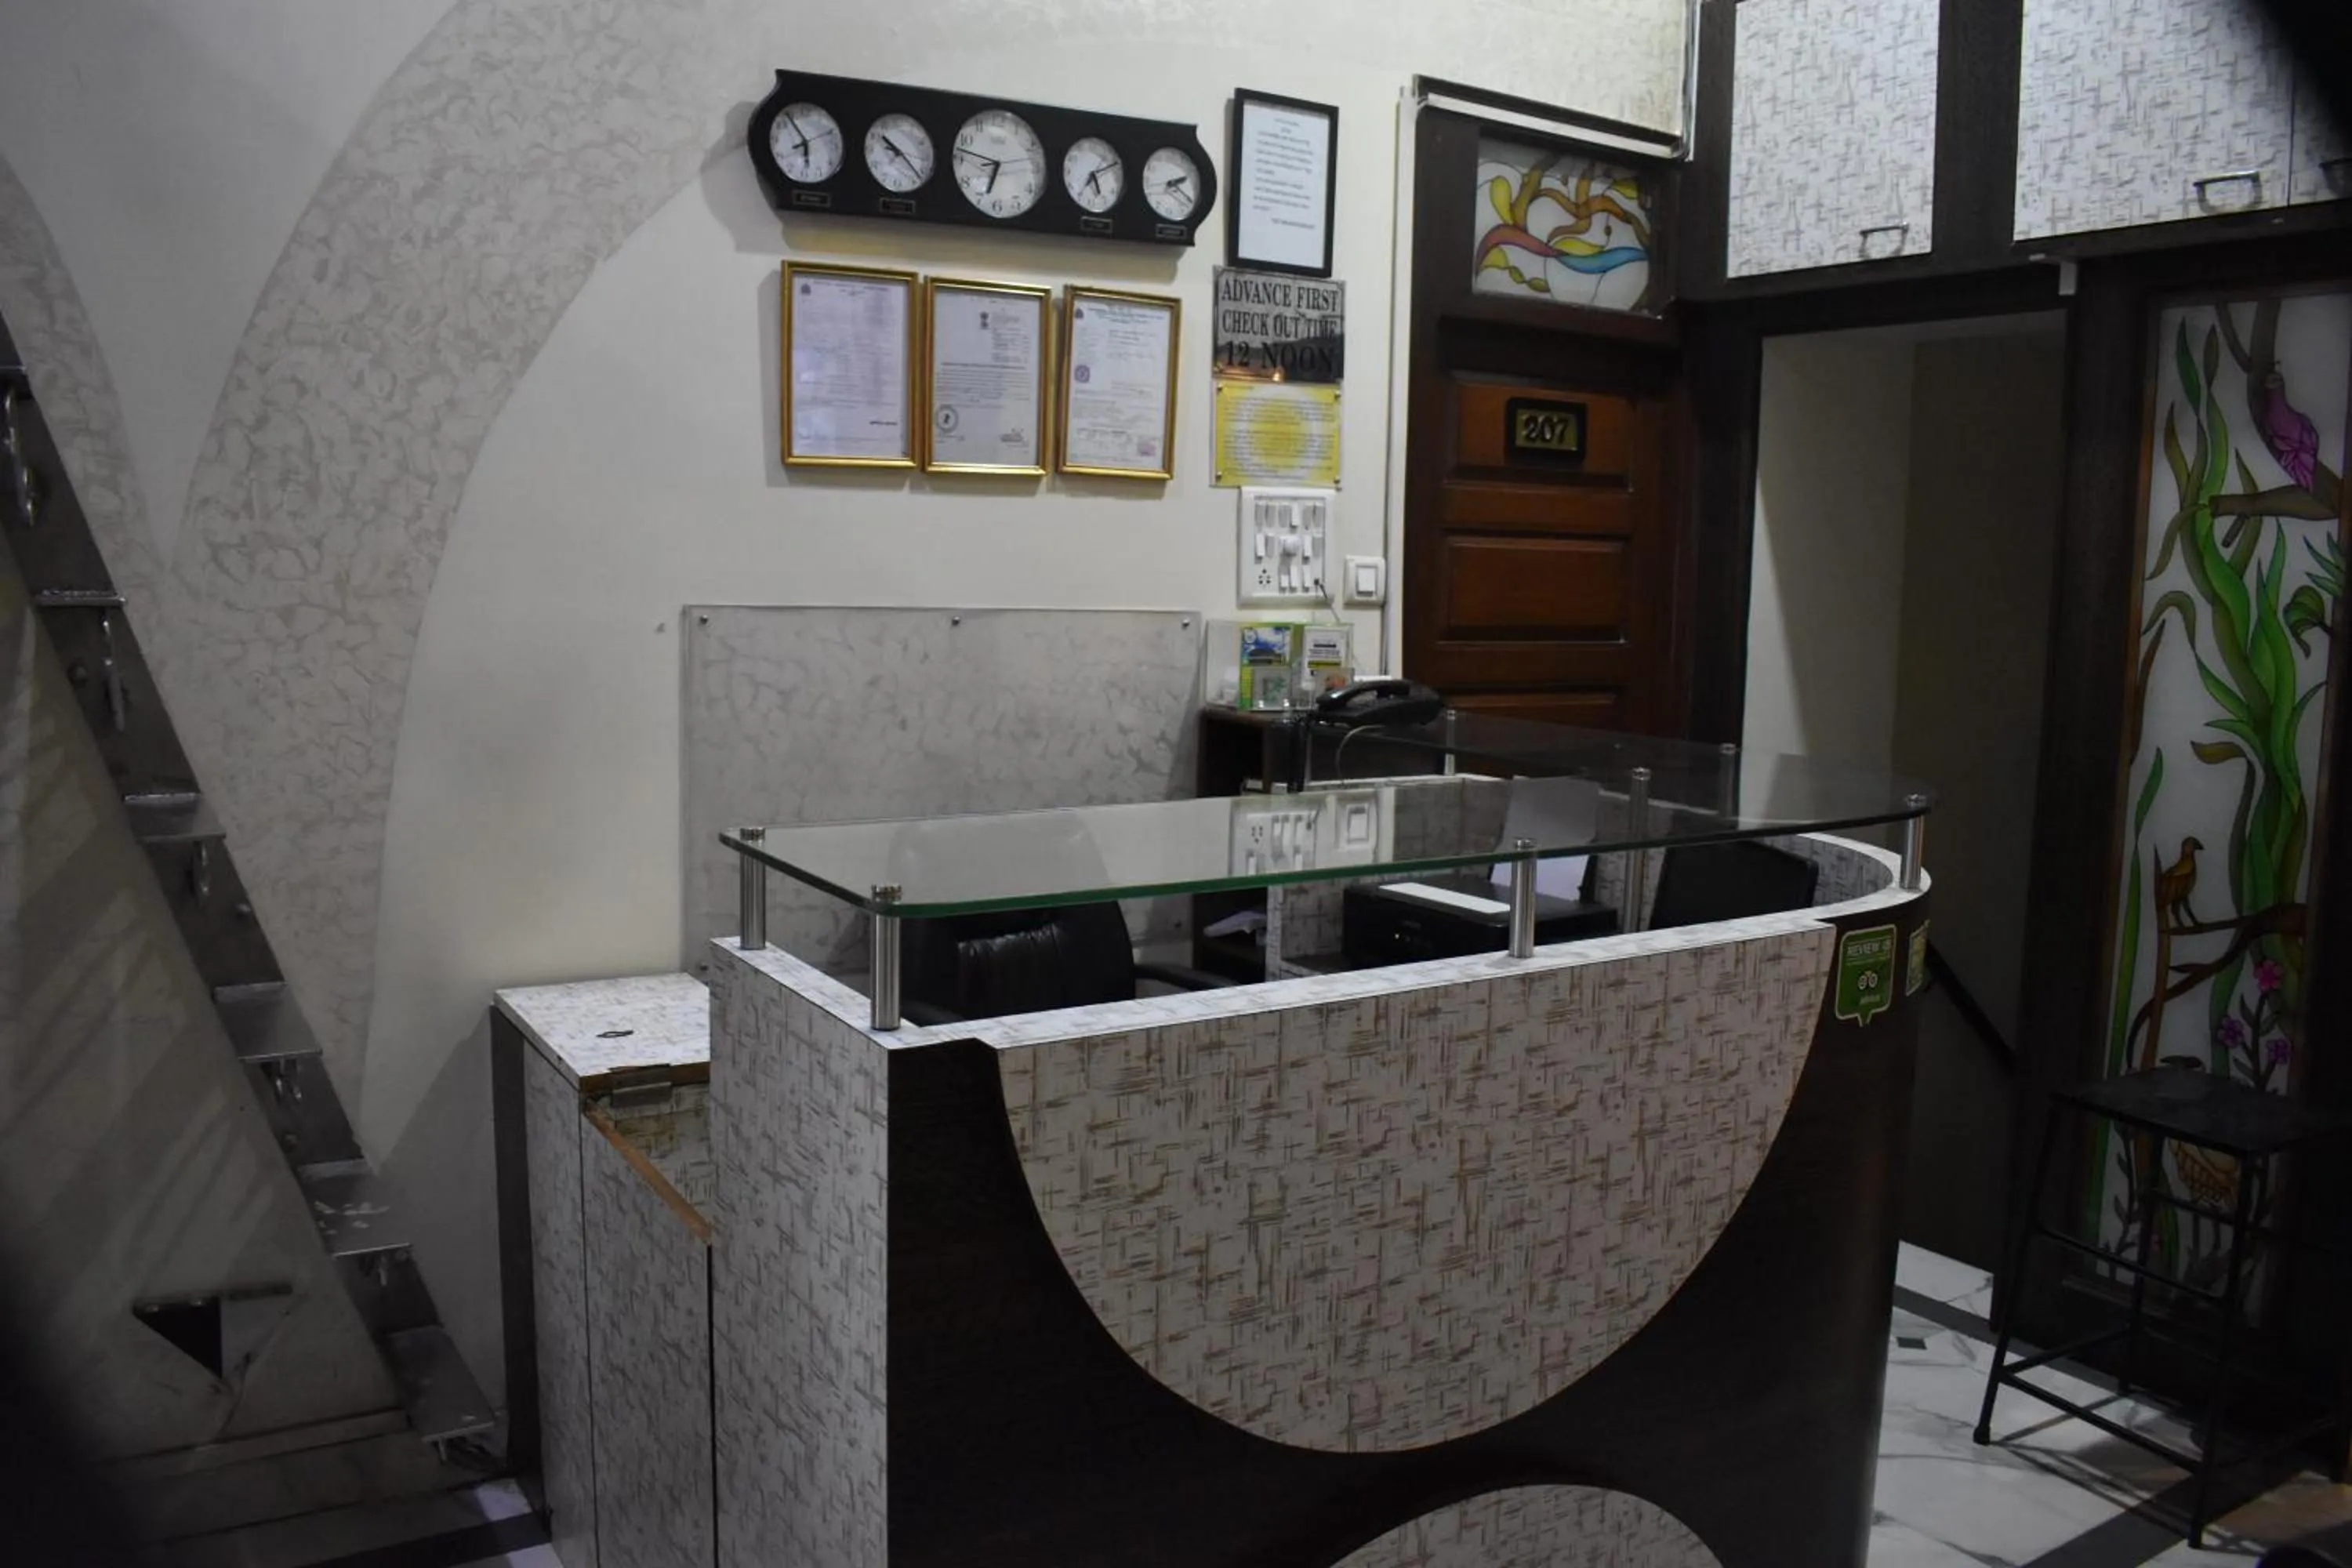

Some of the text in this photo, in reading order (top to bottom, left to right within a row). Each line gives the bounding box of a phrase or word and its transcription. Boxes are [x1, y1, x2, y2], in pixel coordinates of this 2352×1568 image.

[960, 133, 973, 147] 10
[961, 176, 971, 189] 8
[992, 200, 1003, 213] 6
[1221, 278, 1339, 312] ADVANCE FIRST
[1222, 309, 1338, 340] CHECK OUT TIME
[1226, 340, 1336, 373] 12 NOON
[1523, 415, 1569, 444] 207
